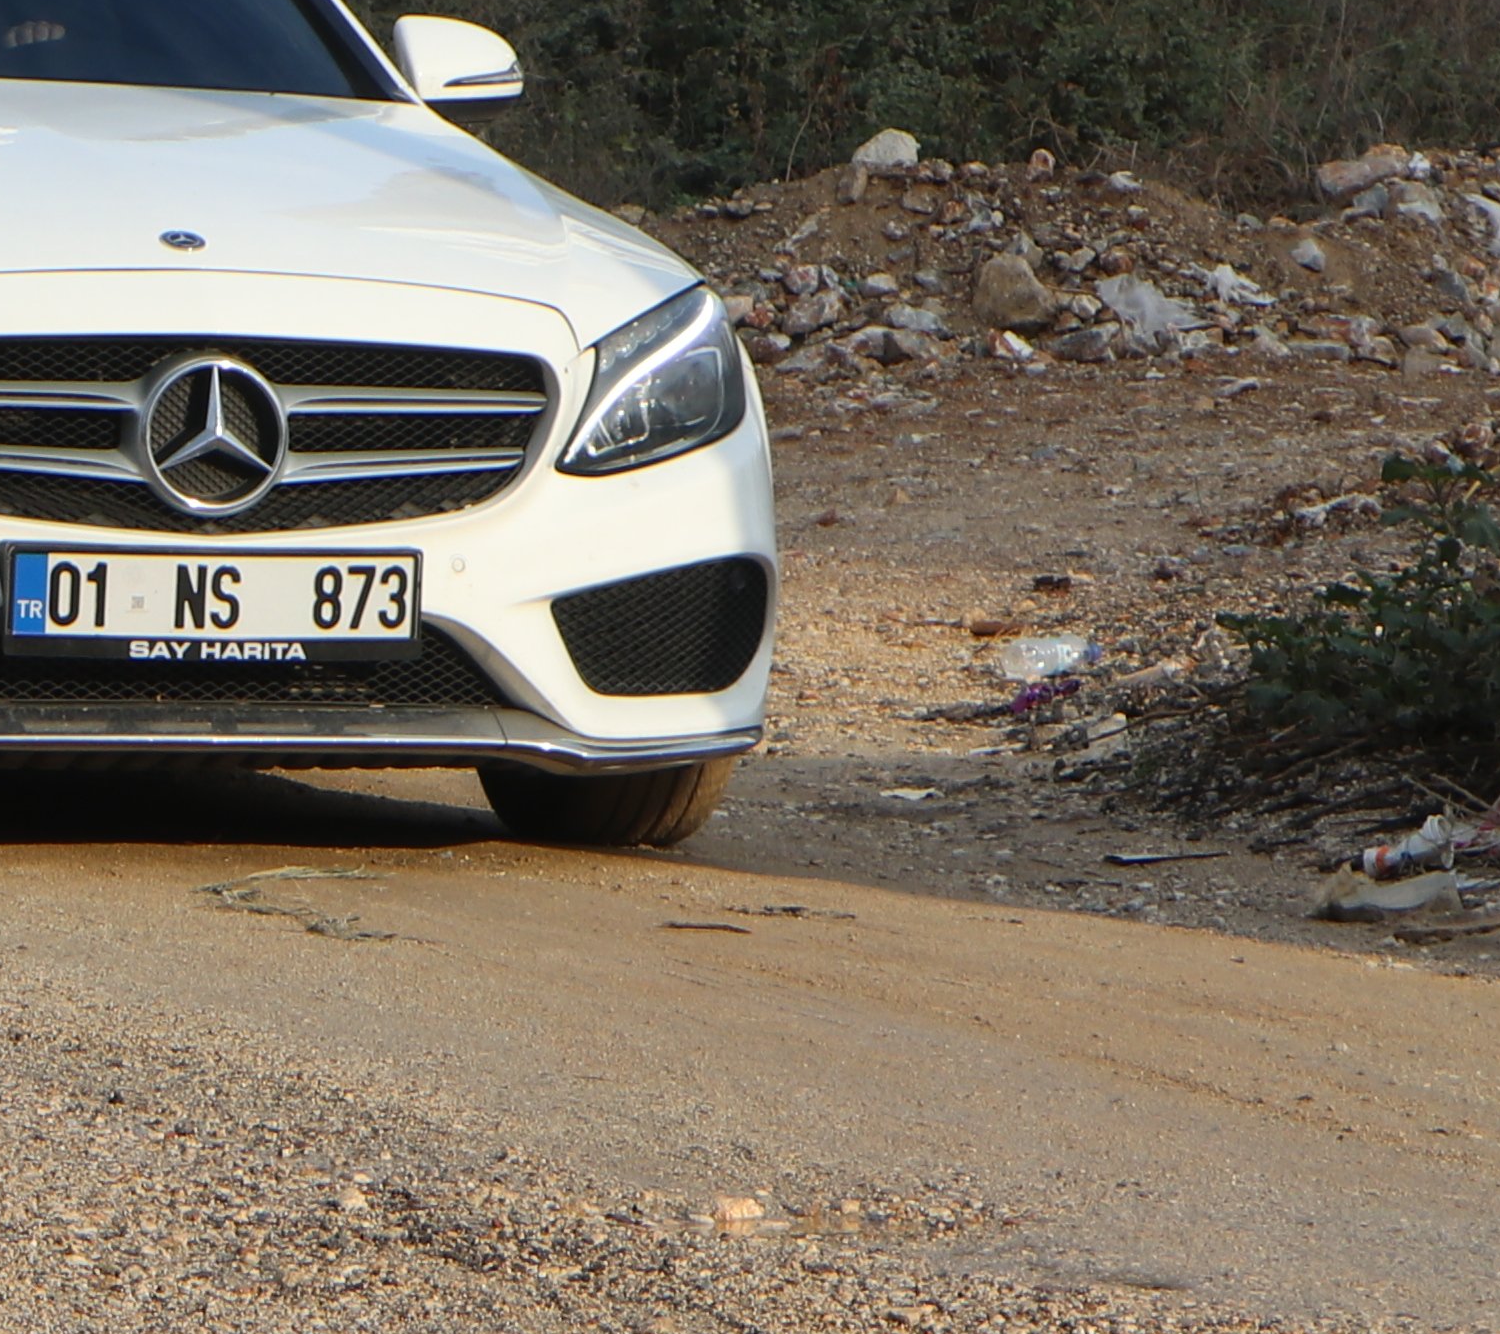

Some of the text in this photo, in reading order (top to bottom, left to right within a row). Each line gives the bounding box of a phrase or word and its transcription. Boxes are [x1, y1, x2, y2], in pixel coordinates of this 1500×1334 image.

[48, 560, 409, 631] 01 NS 873
[17, 599, 43, 620] TR
[128, 640, 192, 659] SAY
